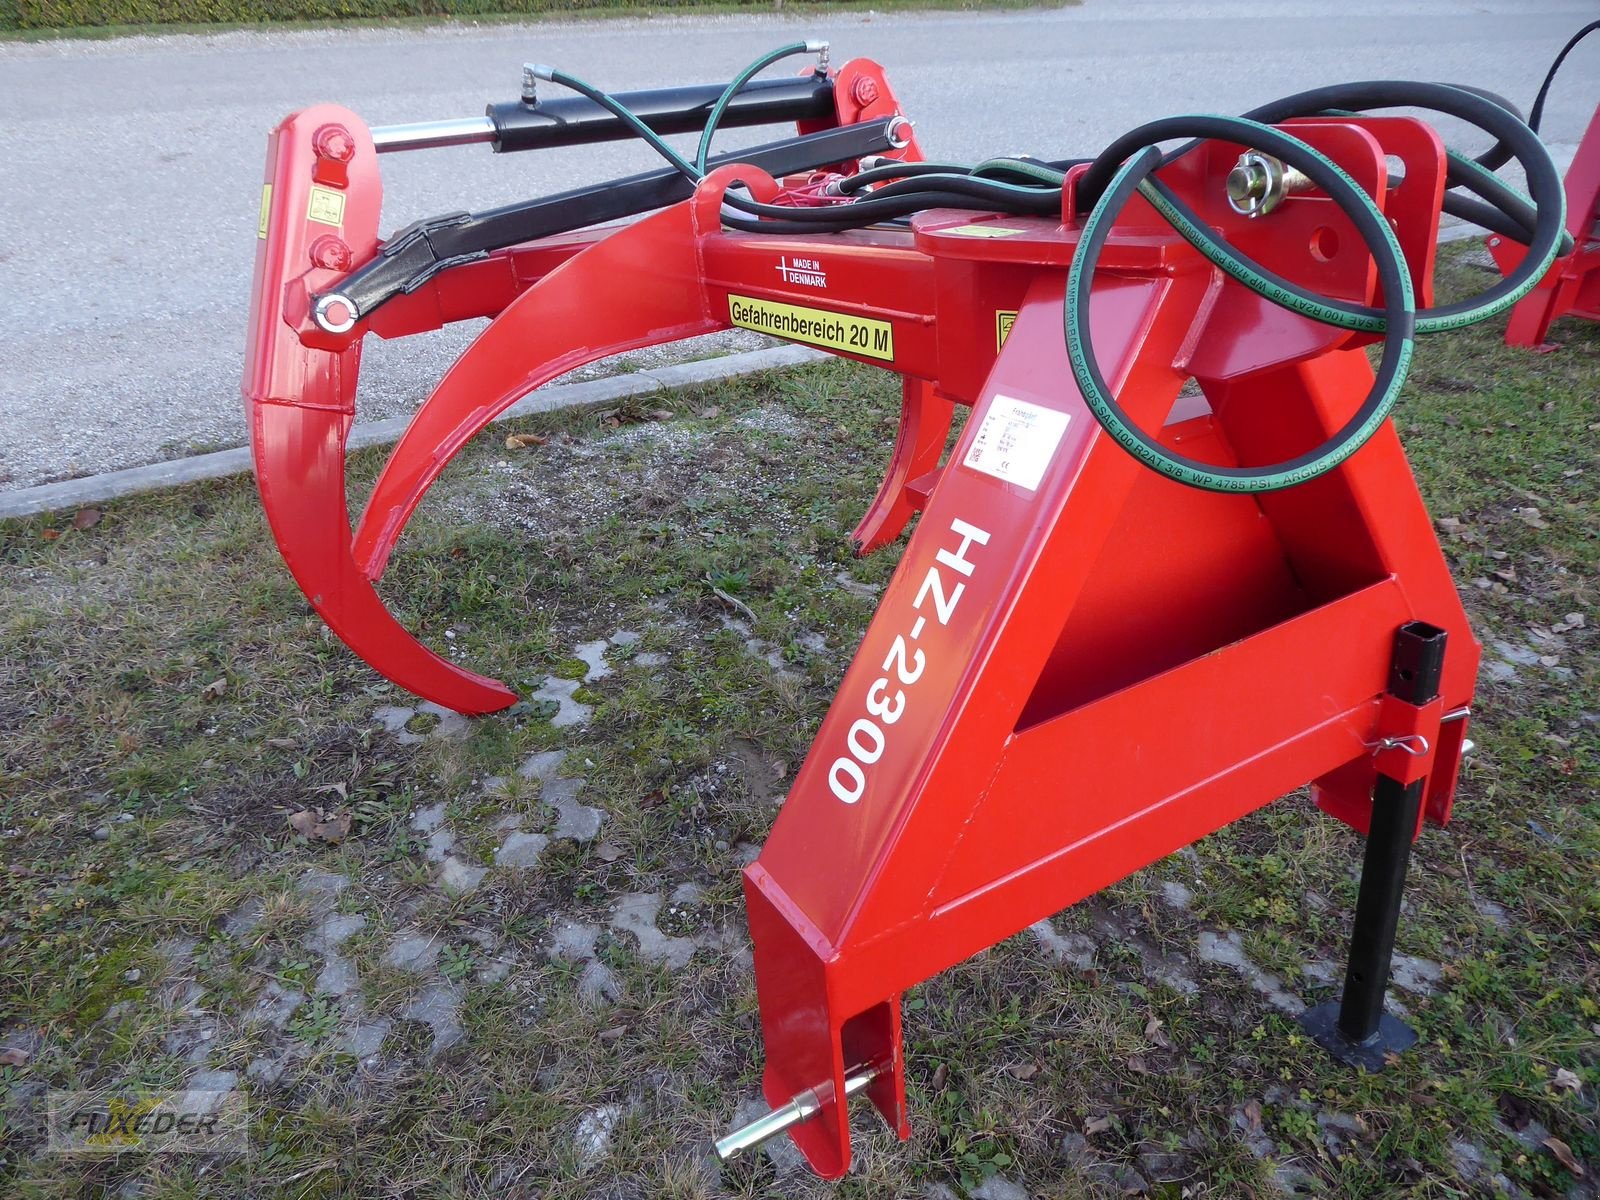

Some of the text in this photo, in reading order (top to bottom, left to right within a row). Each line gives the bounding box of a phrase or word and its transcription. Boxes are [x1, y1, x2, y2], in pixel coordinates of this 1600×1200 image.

[1181, 221, 1207, 248] ARGUS
[793, 258, 819, 271] MADE IN
[1210, 248, 1227, 265] PSI
[1227, 261, 1249, 278] 4785
[789, 273, 827, 288] DENMARK
[1070, 274, 1078, 285] 10
[1249, 278, 1267, 292] WP
[1068, 287, 1076, 305] WP
[1292, 298, 1323, 316] R2AT
[1067, 308, 1075, 326] 330
[1325, 310, 1344, 322] 100
[1349, 318, 1374, 328] SAE
[1441, 317, 1466, 328] BAR
[732, 302, 888, 352] Gefahrenbereich 20 M
[1067, 328, 1079, 353] BAR
[1073, 353, 1101, 407] EXCEEDS
[1097, 406, 1118, 430] SAE
[1115, 429, 1133, 447] 100
[1134, 445, 1165, 467] R2AT
[1192, 473, 1213, 485] WP
[1283, 463, 1327, 485] ARGUS
[1215, 480, 1246, 490] 4785
[1249, 481, 1271, 489] PSI
[828, 517, 991, 804] HZ-2300
